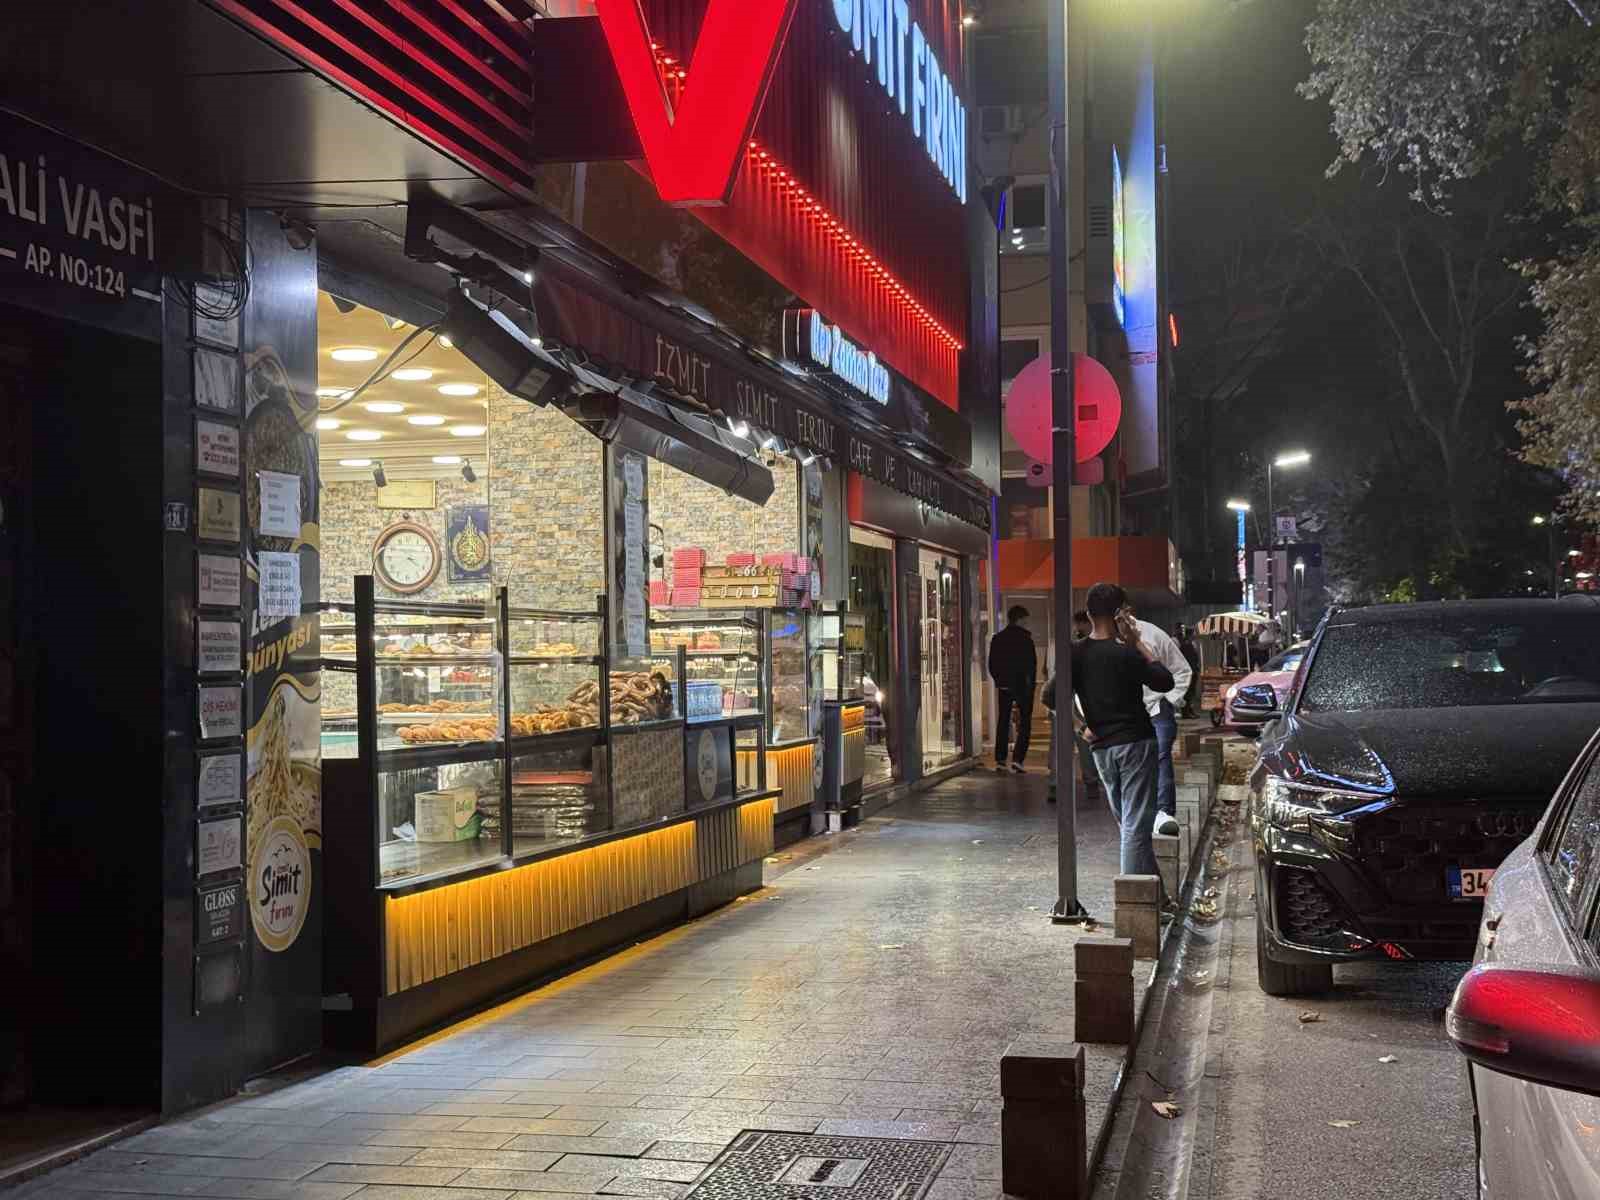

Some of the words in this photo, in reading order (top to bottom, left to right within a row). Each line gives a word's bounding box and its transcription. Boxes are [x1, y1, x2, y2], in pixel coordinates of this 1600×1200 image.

[58, 175, 154, 261] VASFİ
[24, 243, 54, 277] AP.
[59, 252, 126, 298] NO:124
[832, 324, 868, 394] Zaman
[205, 888, 236, 912] GLOSS
[260, 864, 301, 906] Simit
[1463, 872, 1488, 894] 34
